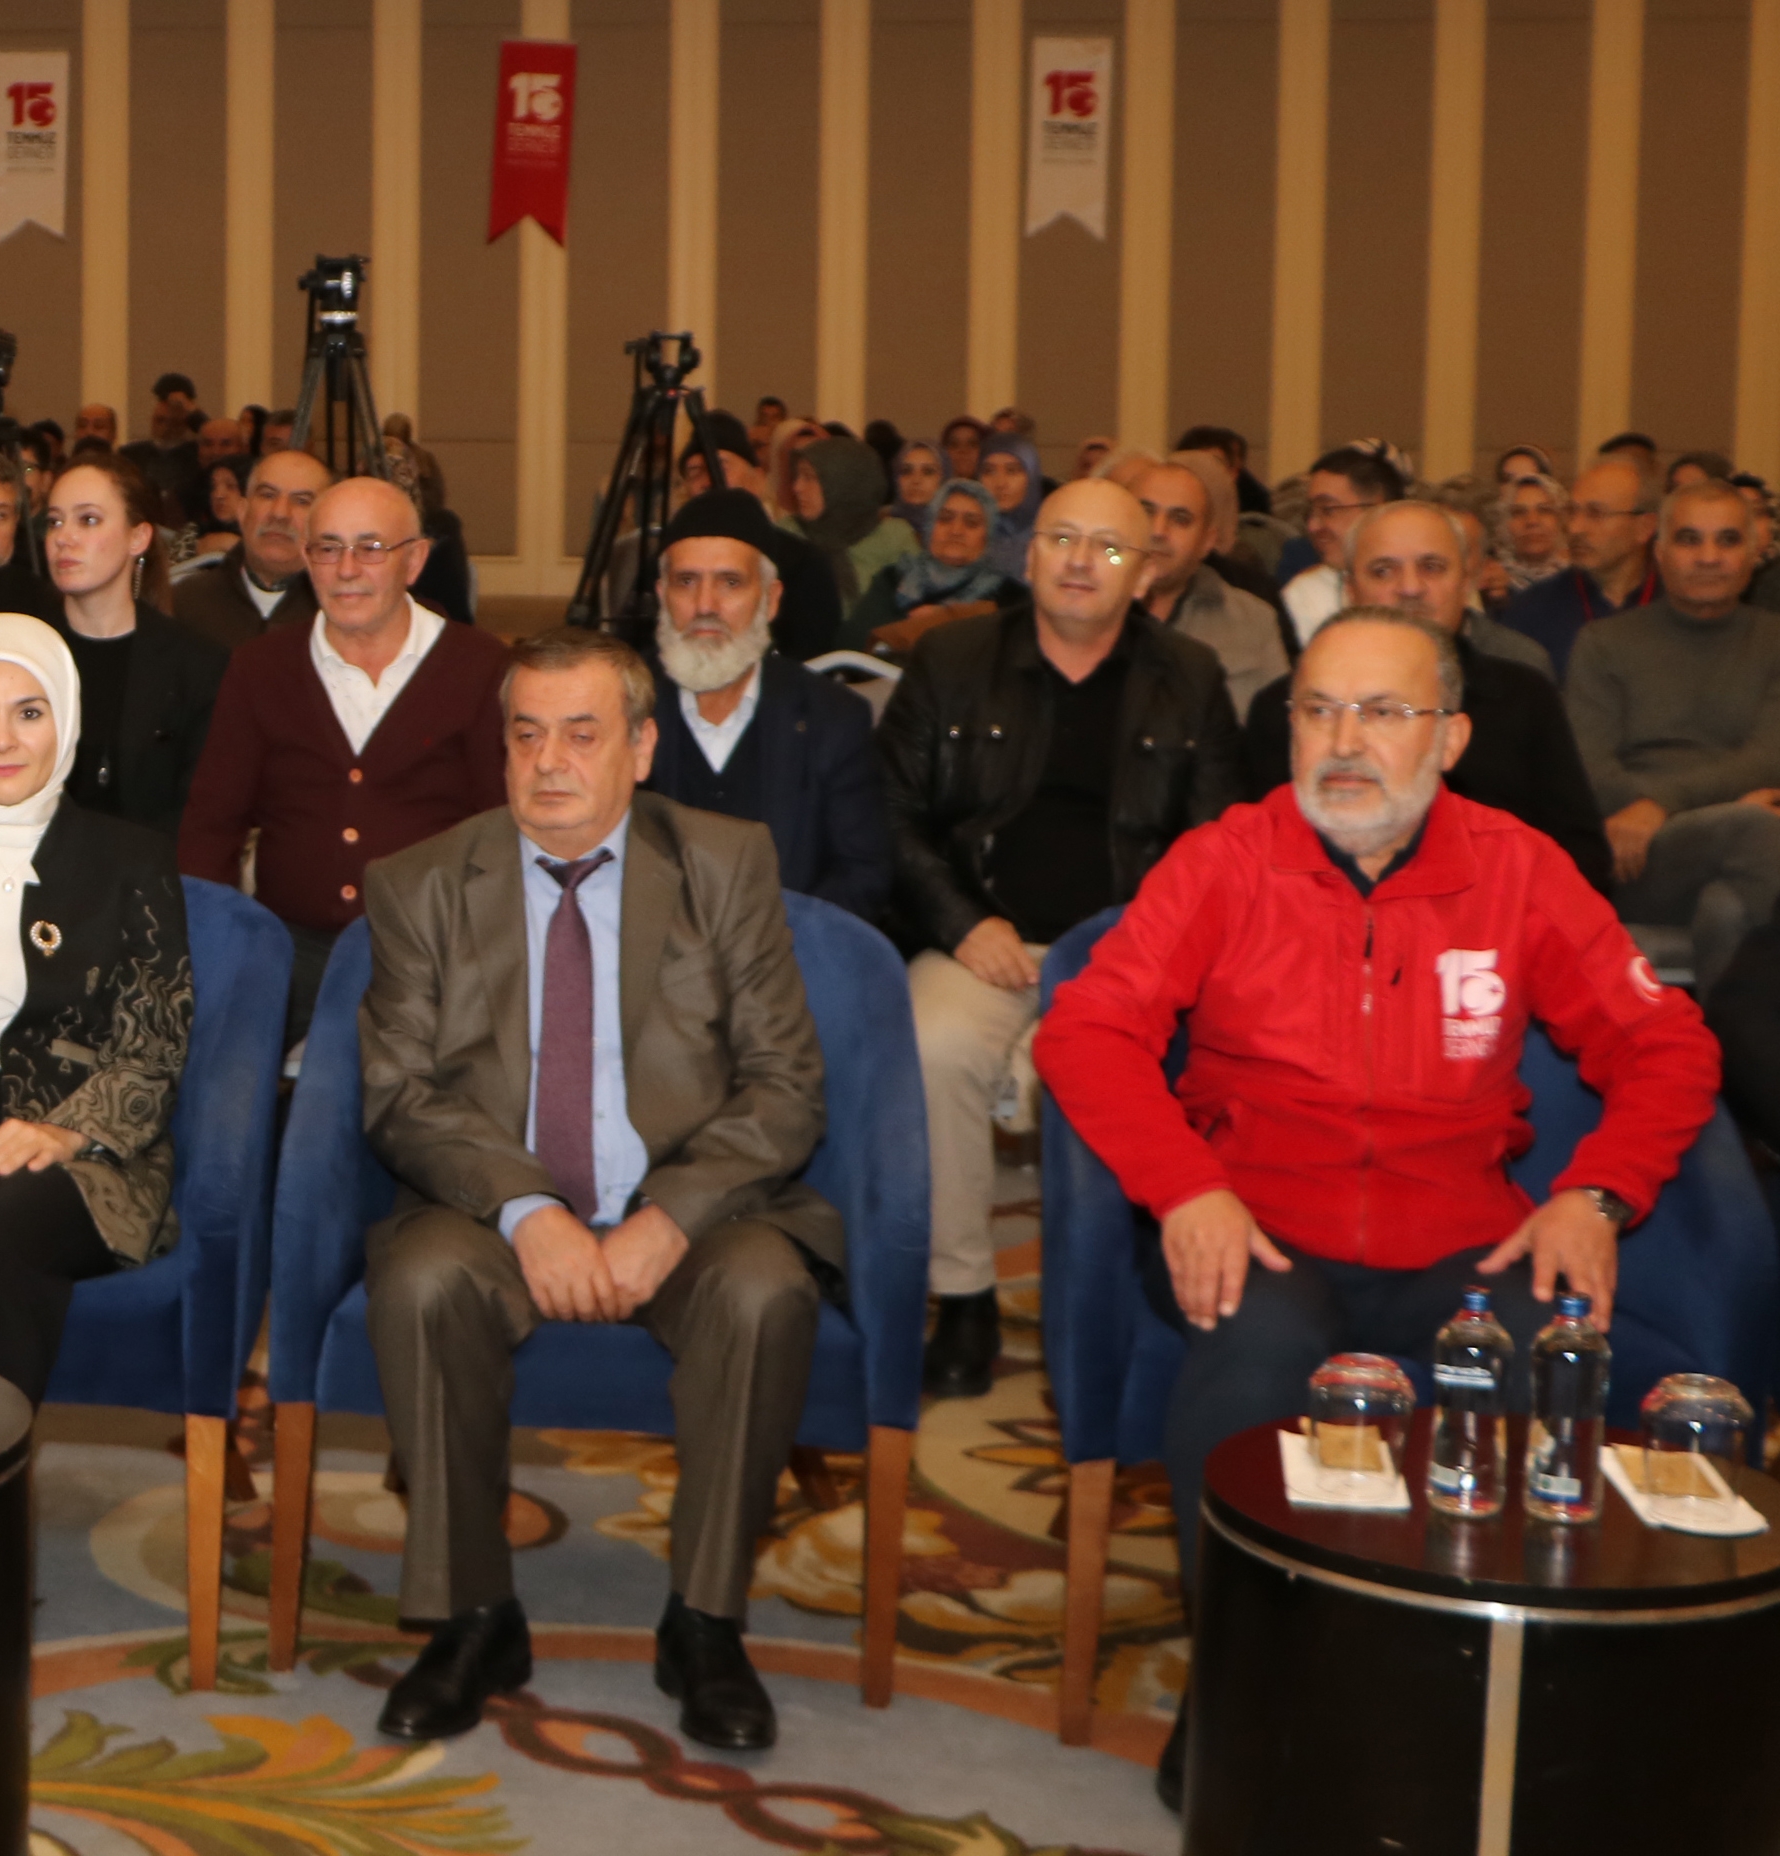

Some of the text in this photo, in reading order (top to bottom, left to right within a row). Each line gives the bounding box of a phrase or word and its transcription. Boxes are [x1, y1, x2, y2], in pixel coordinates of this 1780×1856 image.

[6, 82, 57, 127] 15
[508, 72, 563, 121] 15
[1045, 70, 1098, 117] 15
[1435, 948, 1506, 1017] 15
